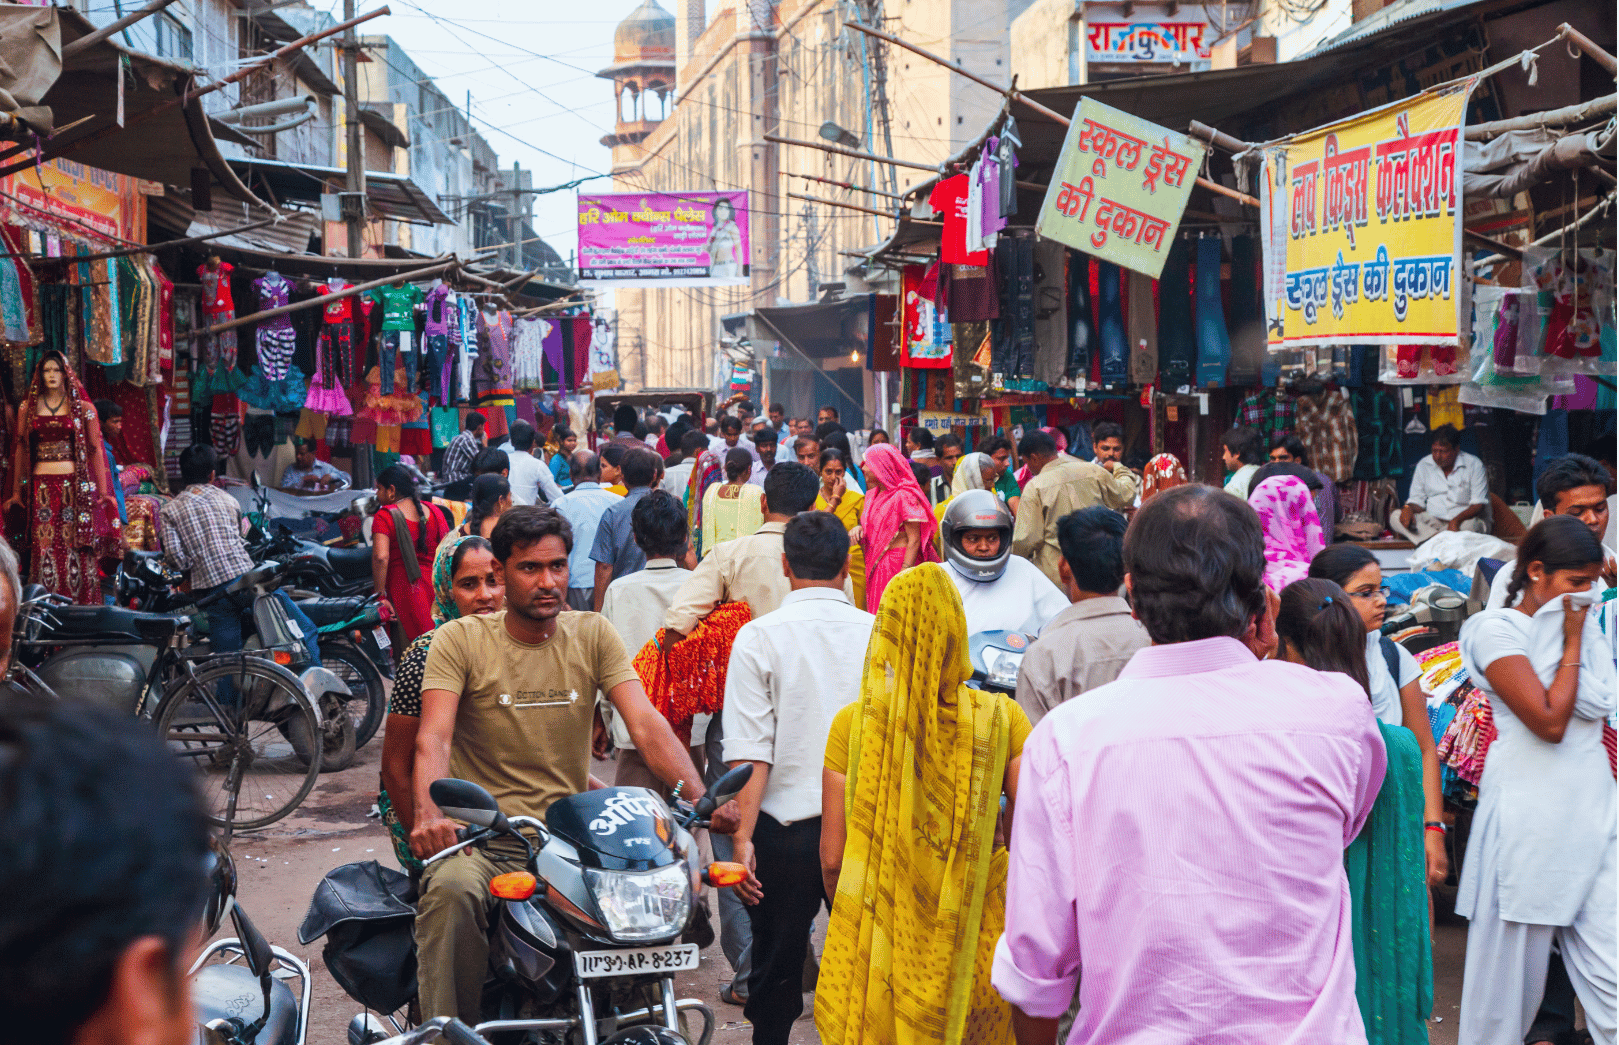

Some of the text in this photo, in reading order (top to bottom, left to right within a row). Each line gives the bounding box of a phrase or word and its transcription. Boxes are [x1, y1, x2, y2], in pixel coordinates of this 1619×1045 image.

[1088, 22, 1211, 59] राजकुमार
[1078, 118, 1193, 194] स्कूल ड्रेस
[1290, 158, 1320, 240] लव
[1322, 133, 1373, 251] किड्स
[579, 208, 600, 225] हरि
[602, 208, 628, 223] ओम
[1056, 175, 1172, 251] की दुकान
[1286, 267, 1330, 325] स्कूल
[1363, 244, 1390, 301] की
[1394, 256, 1455, 322] दुकान
[623, 837, 651, 847] TVS
